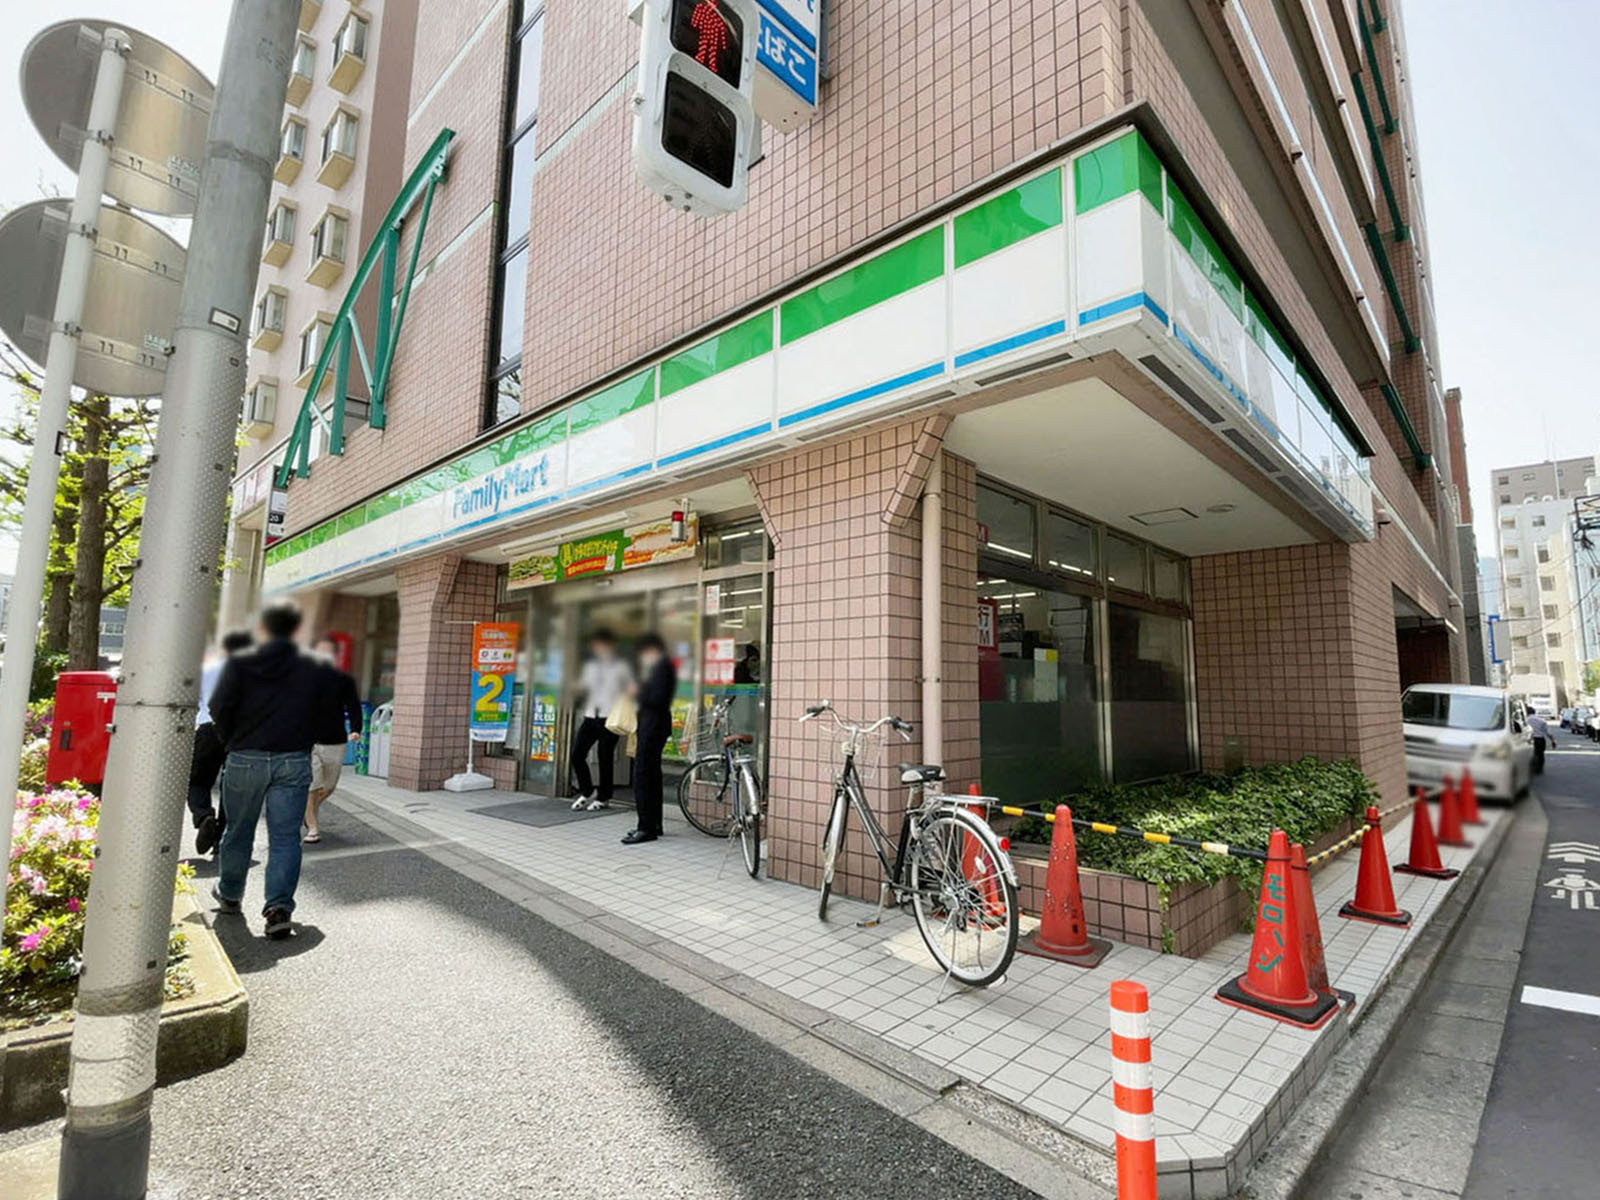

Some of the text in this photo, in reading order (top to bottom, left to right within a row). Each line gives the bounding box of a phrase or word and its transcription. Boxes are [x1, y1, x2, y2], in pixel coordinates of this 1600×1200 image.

[757, 27, 806, 85] ばこ
[453, 453, 548, 519] FamilyMart
[475, 674, 504, 712] 2
